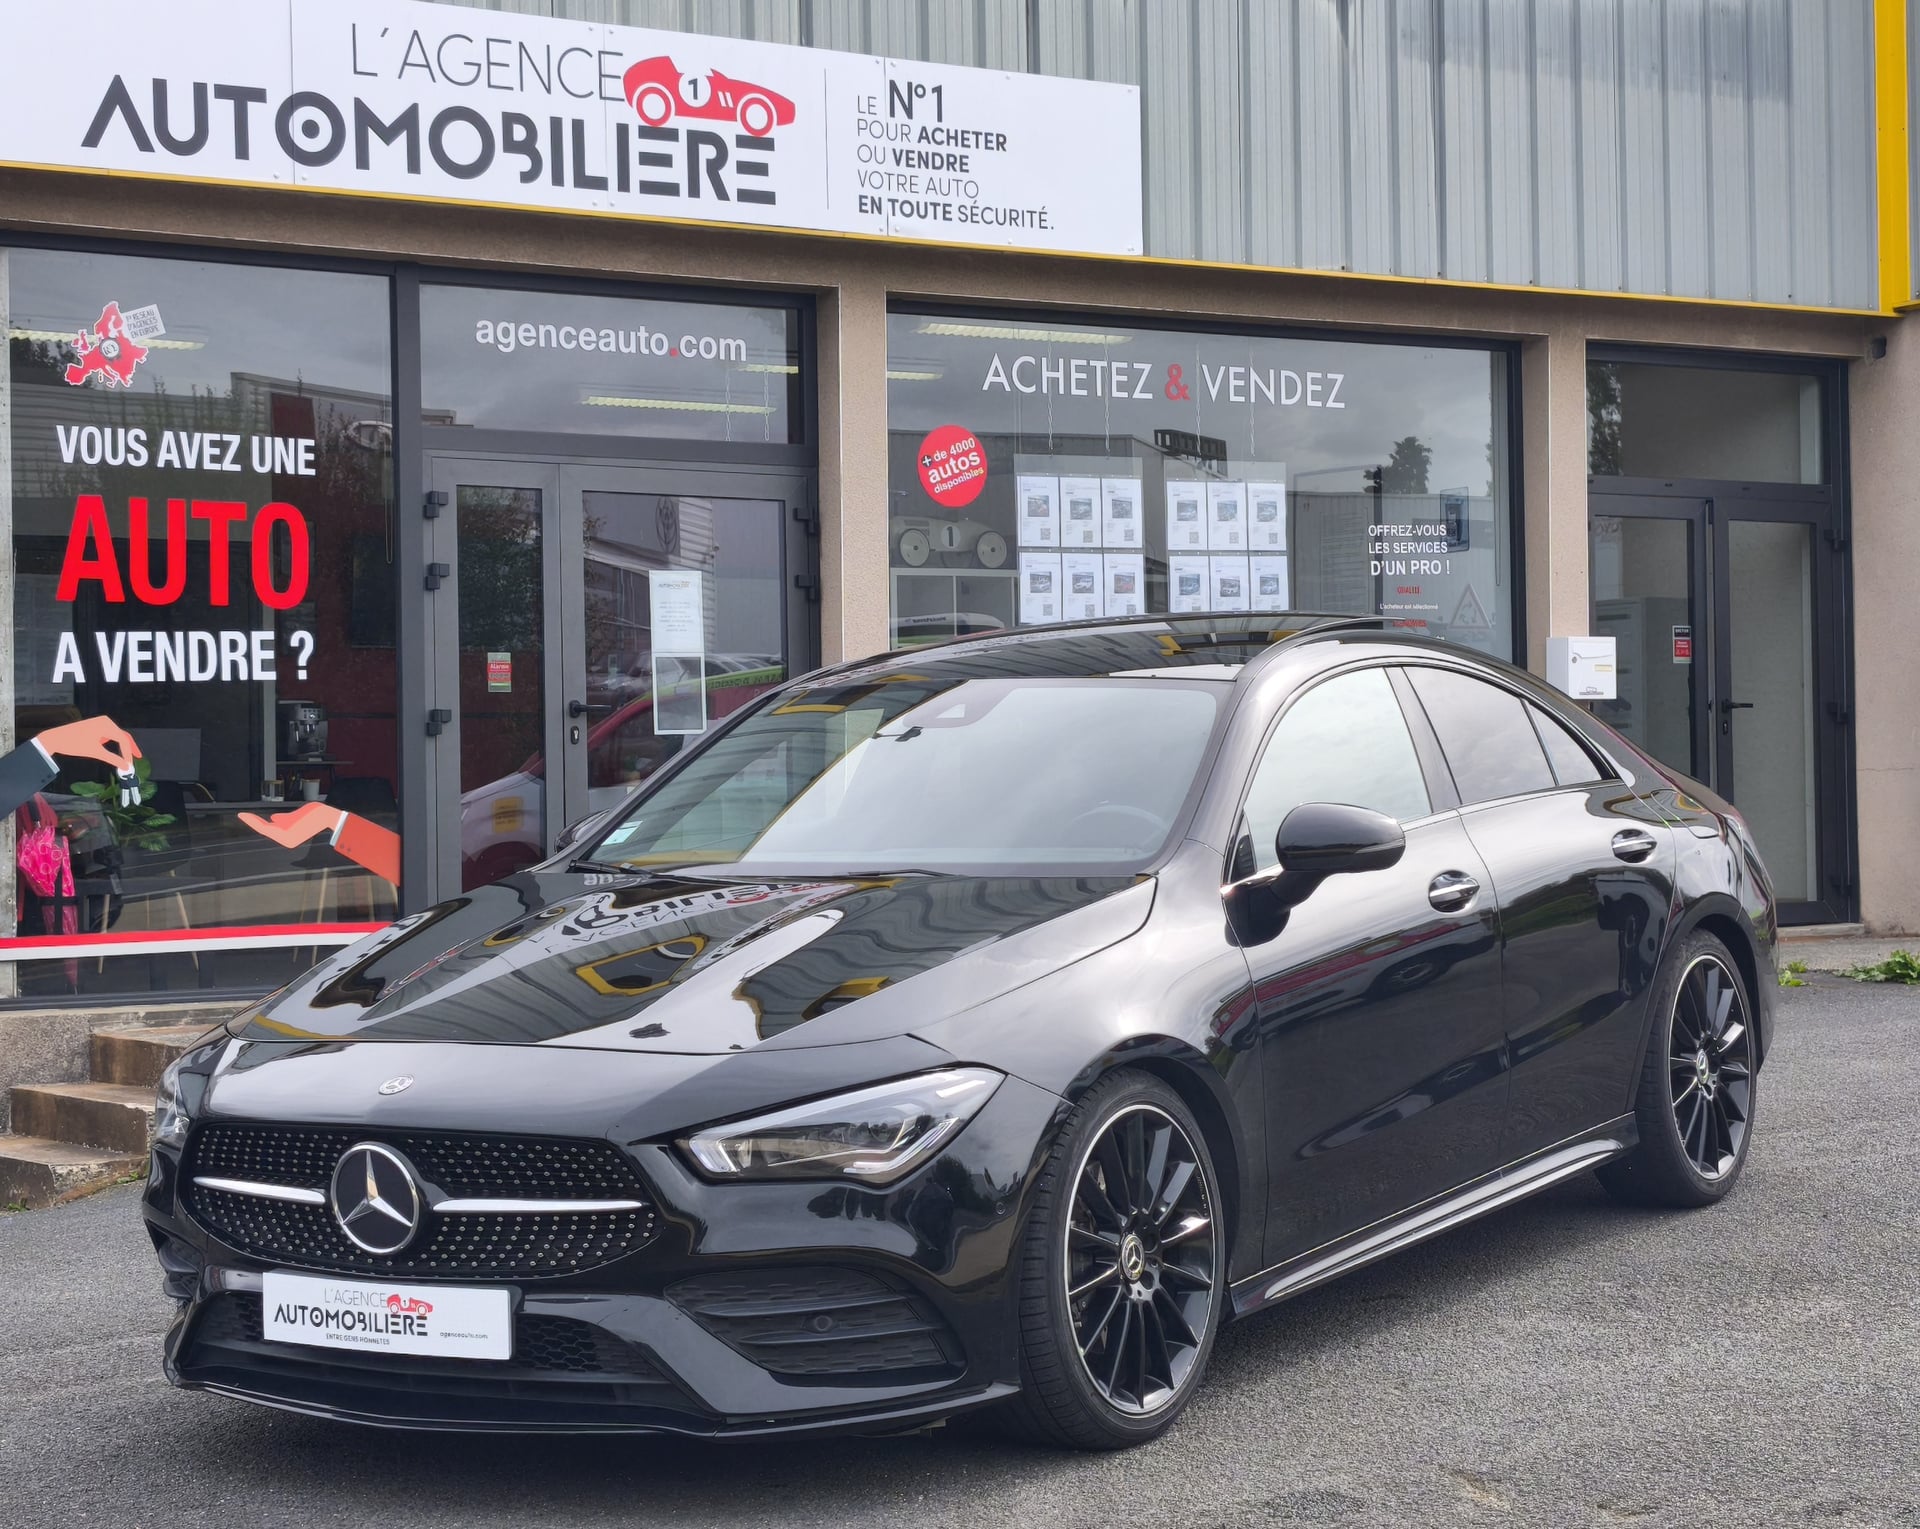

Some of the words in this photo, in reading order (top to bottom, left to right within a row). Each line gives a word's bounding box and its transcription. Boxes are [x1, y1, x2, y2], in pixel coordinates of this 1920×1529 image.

[351, 22, 625, 103] L'AGENCE
[857, 94, 878, 116] LE
[81, 73, 776, 206] AUTOMOBILIERE
[857, 118, 912, 144] POUR
[917, 126, 1007, 152] ACHETER
[857, 143, 887, 165] OU
[892, 149, 969, 174] VENDRE
[858, 169, 920, 196] VOTRE
[925, 175, 979, 199] AUTO
[858, 194, 883, 216] EN
[887, 199, 953, 222] TOUTE
[957, 200, 1055, 231] SÉCURITÉ.
[475, 319, 748, 362] agenceauto.com
[982, 352, 1154, 400] ACHETEZ
[1164, 362, 1191, 402] &
[1201, 363, 1346, 409] VENDEZ
[56, 424, 149, 466] VOUS
[157, 431, 241, 472] AVEZ
[251, 436, 316, 476] UNE
[933, 450, 948, 462] de
[949, 437, 976, 456] 4000
[928, 451, 980, 484] autos
[934, 466, 984, 494] disponibles
[1368, 524, 1447, 537] OFFREZ-VOUS
[55, 494, 310, 610] AUTO
[1368, 542, 1390, 554] LES
[1393, 541, 1448, 554] SERVICES
[1370, 560, 1406, 576] D'UN
[1410, 560, 1442, 575] PRO
[52, 631, 86, 684] A
[95, 630, 277, 683] VENDRE
[290, 630, 314, 681] ?
[324, 1287, 387, 1309] L'AGENCE
[274, 1303, 428, 1337] AUTOMOBILIERE
[326, 1333, 343, 1341] ENTRE
[343, 1334, 359, 1342] GENS
